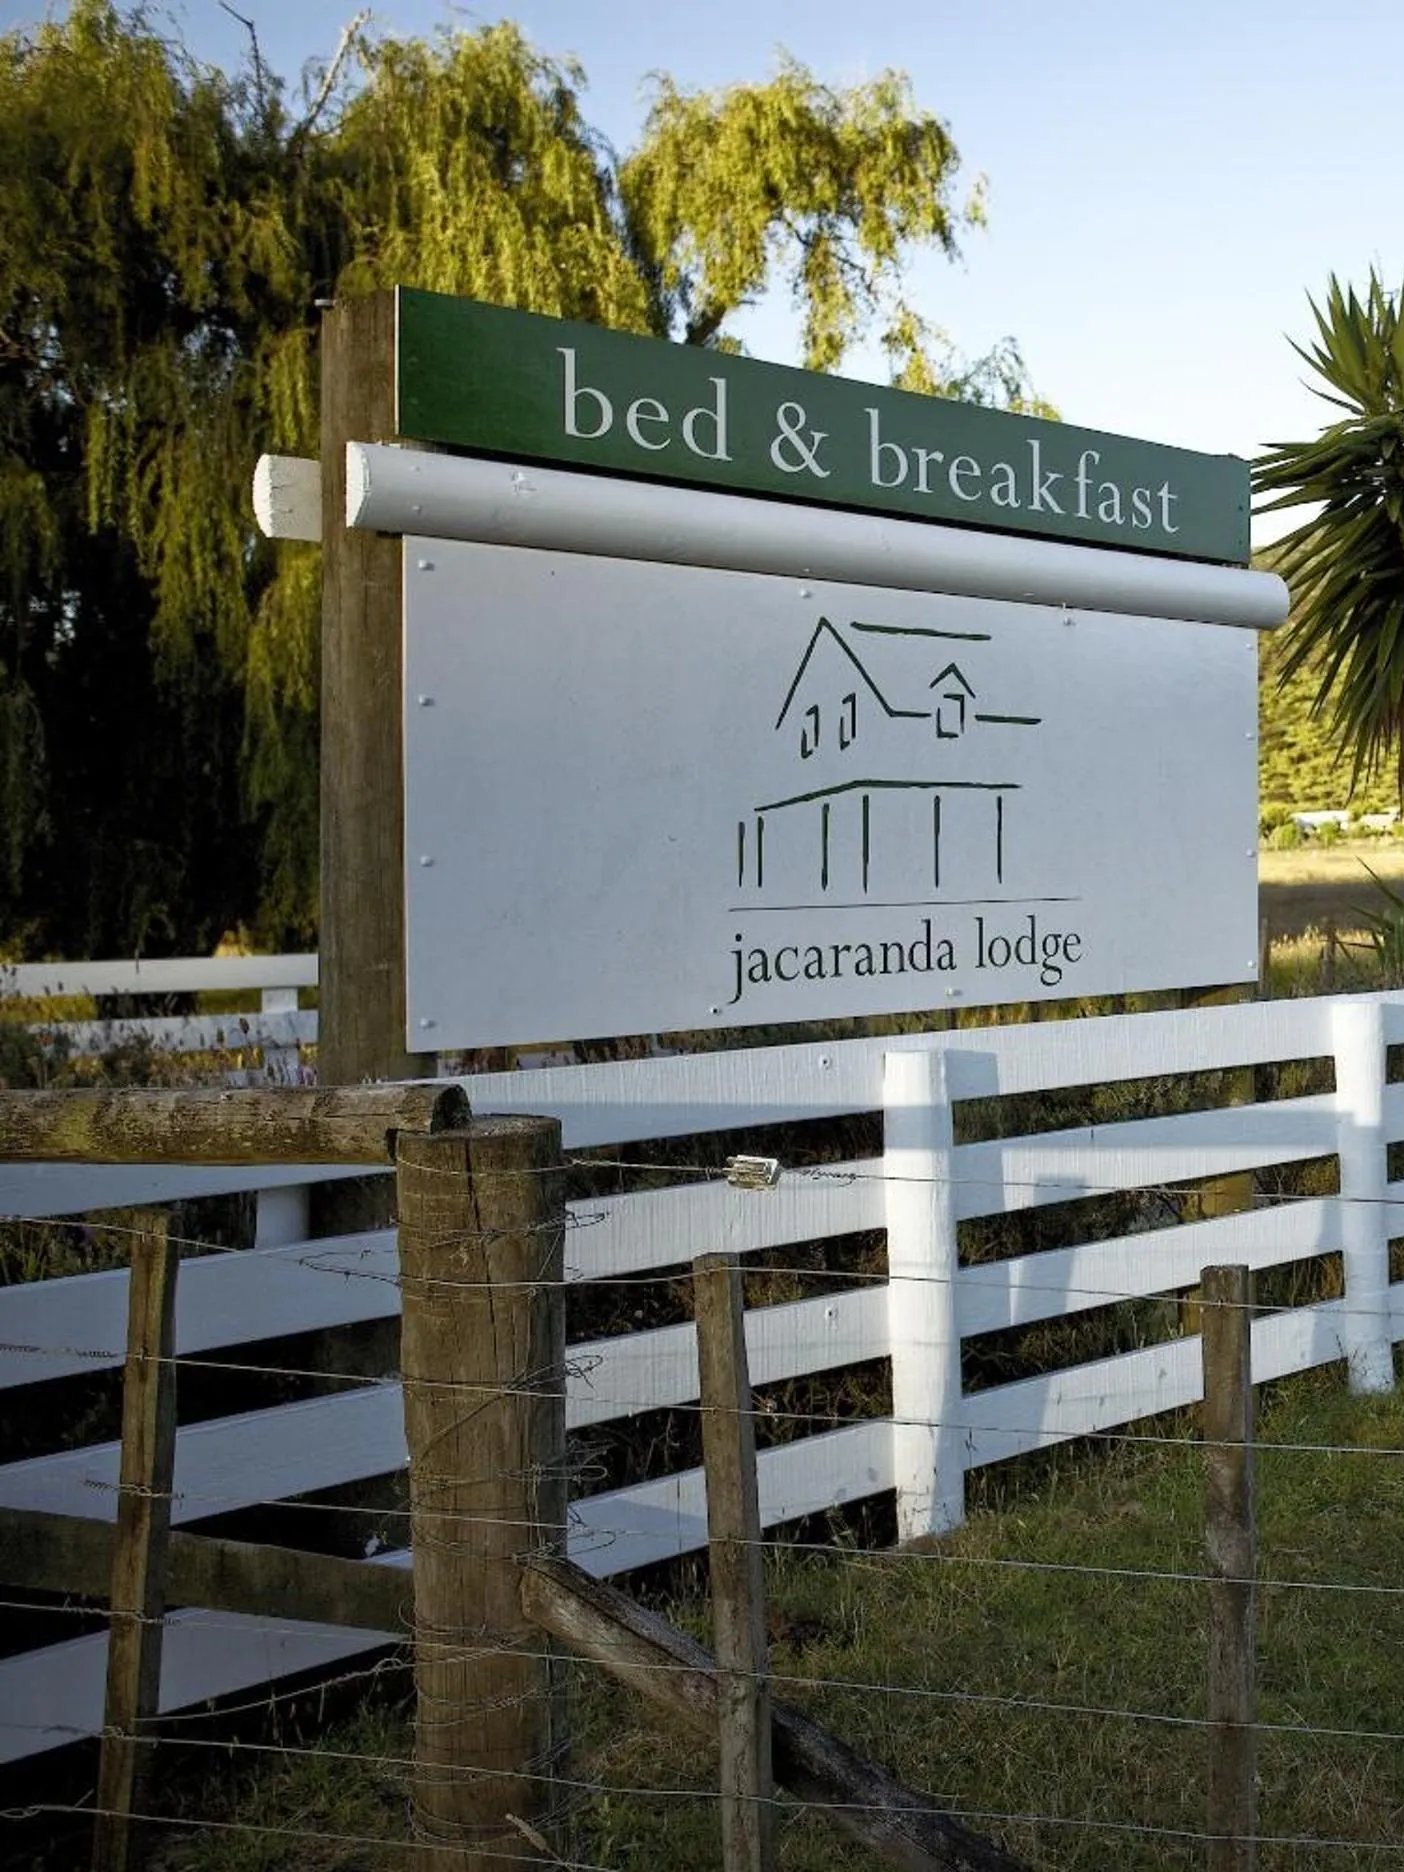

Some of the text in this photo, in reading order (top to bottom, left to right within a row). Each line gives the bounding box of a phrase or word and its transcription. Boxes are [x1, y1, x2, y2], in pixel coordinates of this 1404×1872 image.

[556, 347, 1180, 535] bed & breakfast
[727, 914, 1083, 1006] jacaranda lodge
